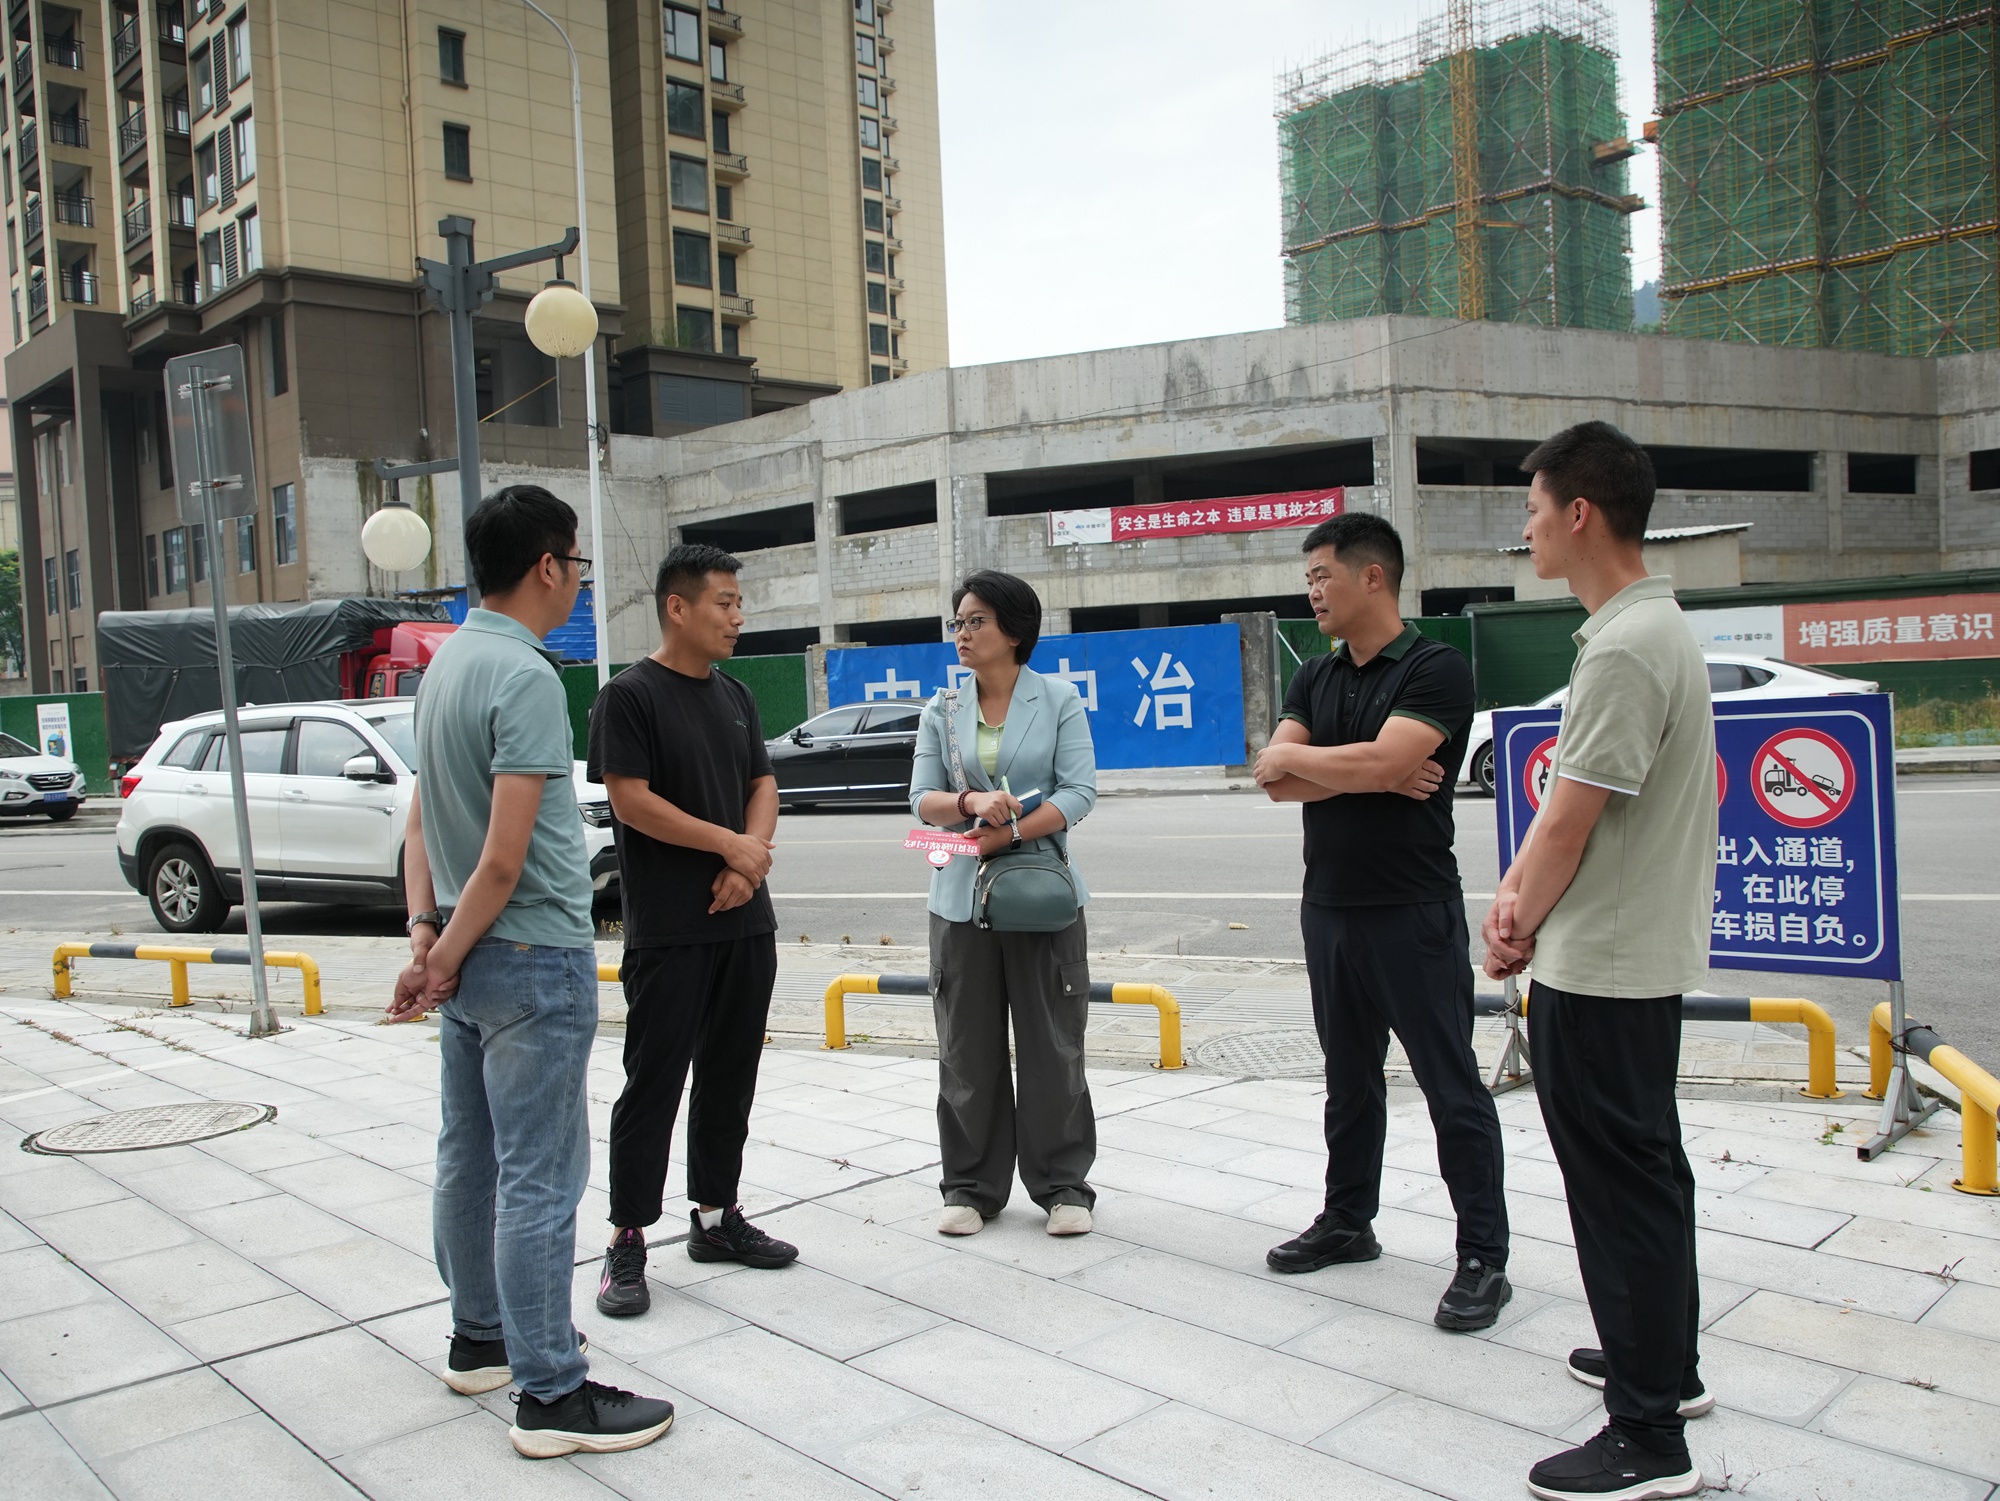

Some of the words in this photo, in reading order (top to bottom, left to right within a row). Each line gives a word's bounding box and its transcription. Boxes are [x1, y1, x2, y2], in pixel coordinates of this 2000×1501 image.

[1118, 508, 1221, 532] 安全是生命之本
[1227, 498, 1336, 524] 违章是事故之源
[1798, 612, 1994, 649] 增强质量意识
